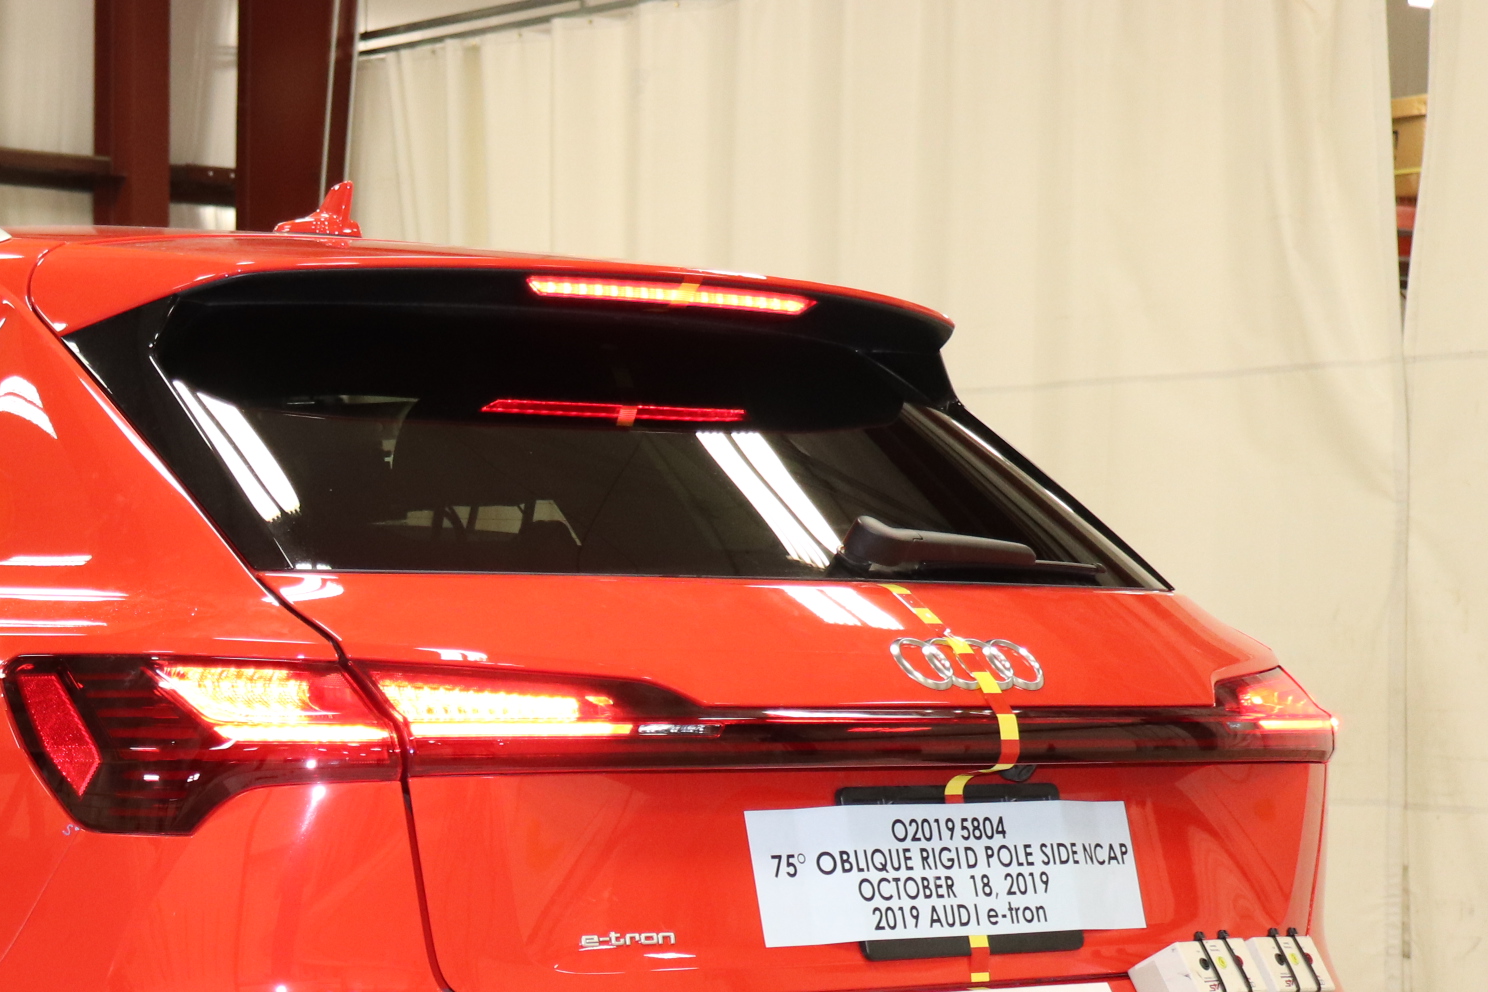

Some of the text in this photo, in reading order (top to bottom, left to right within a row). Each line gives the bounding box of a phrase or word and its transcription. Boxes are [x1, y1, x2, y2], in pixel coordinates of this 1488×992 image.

[816, 848, 915, 876] OBLIQUE
[919, 846, 978, 870] RIGID
[984, 844, 1035, 868] POLE
[1039, 842, 1080, 866] SIDE
[1082, 842, 1128, 866] NCAP
[858, 871, 1049, 902] OCTOBER 18, 2019
[872, 901, 1048, 930] 2019 AUDI e-tron
[580, 931, 676, 947] e-tron
